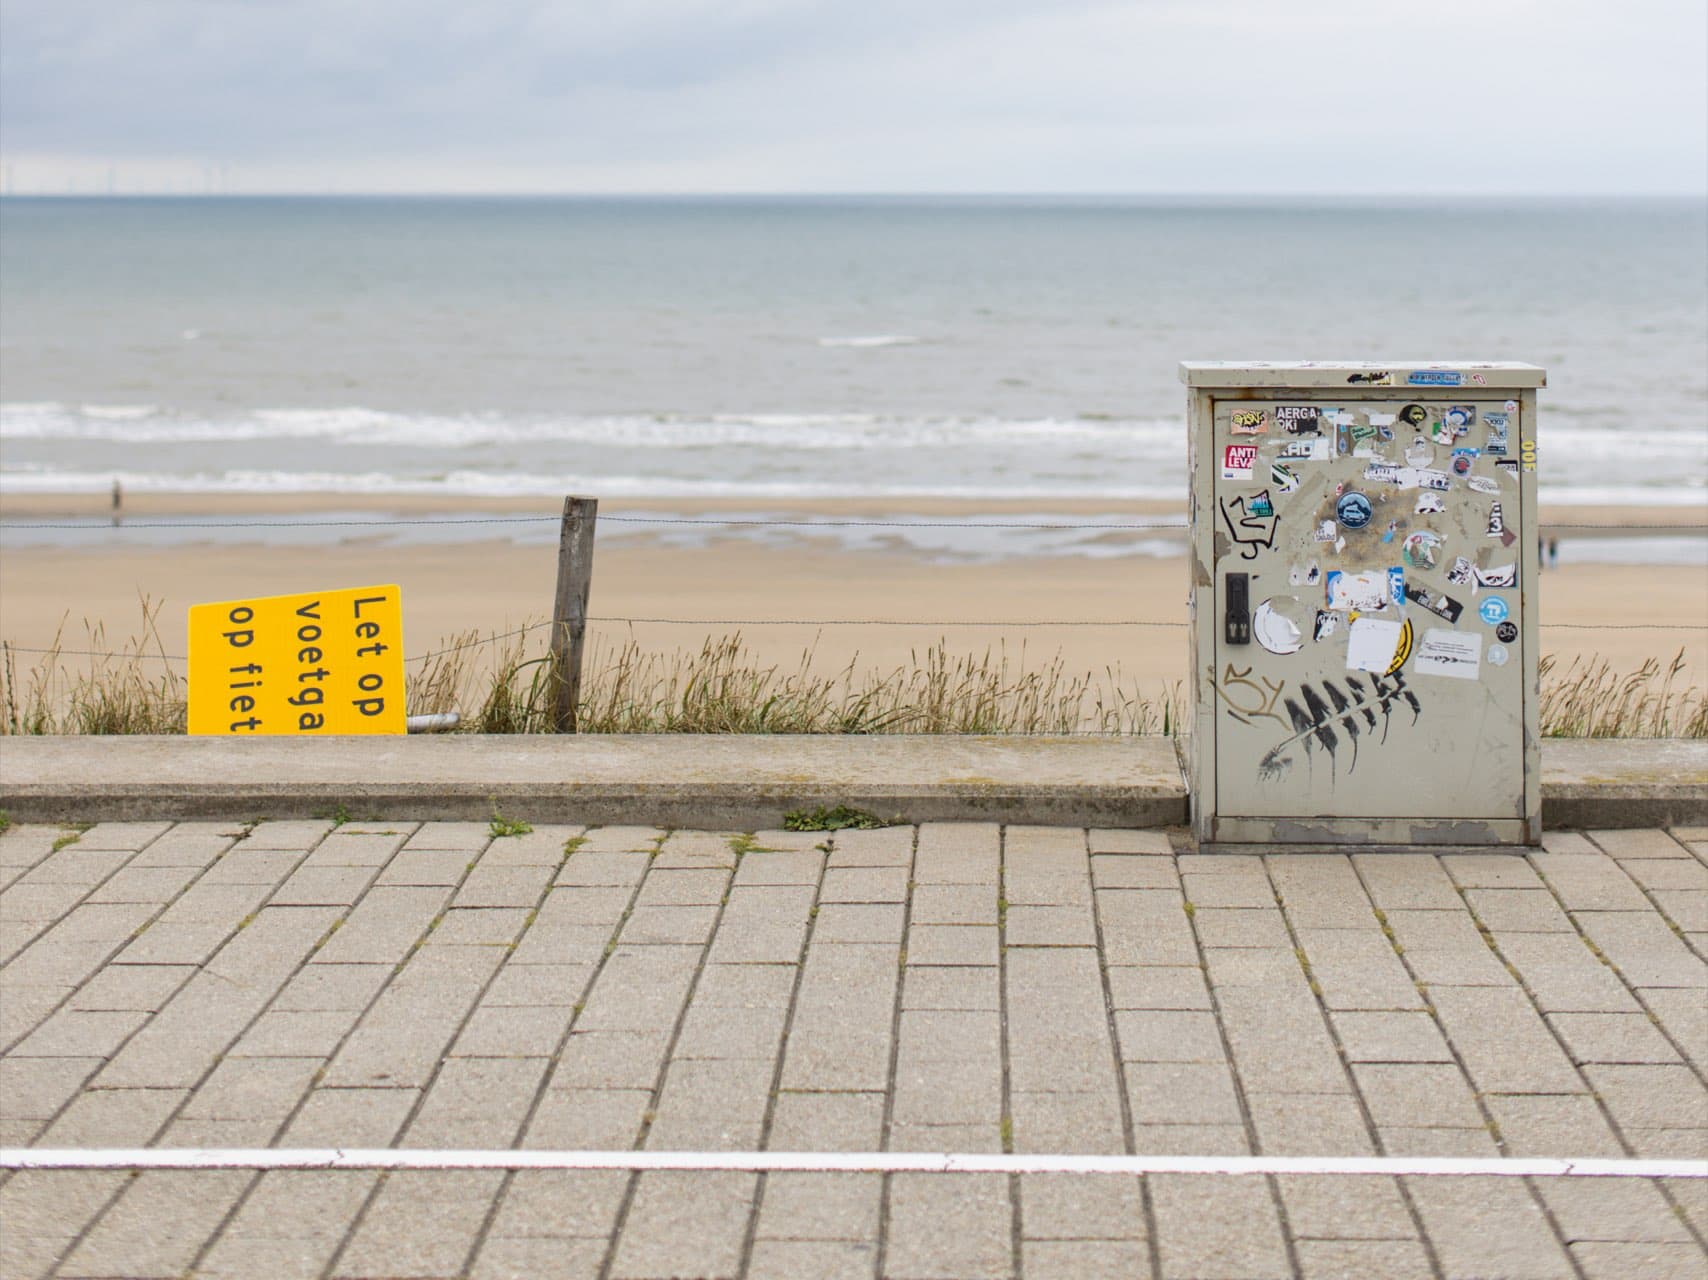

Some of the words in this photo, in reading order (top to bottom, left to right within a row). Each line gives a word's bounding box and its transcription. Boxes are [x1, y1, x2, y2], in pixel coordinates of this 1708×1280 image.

[1229, 447, 1256, 458] ANTI
[222, 606, 254, 648] op
[353, 596, 388, 657] Let
[288, 600, 330, 730] voetga
[229, 663, 263, 732] fiet
[352, 673, 385, 717] op
